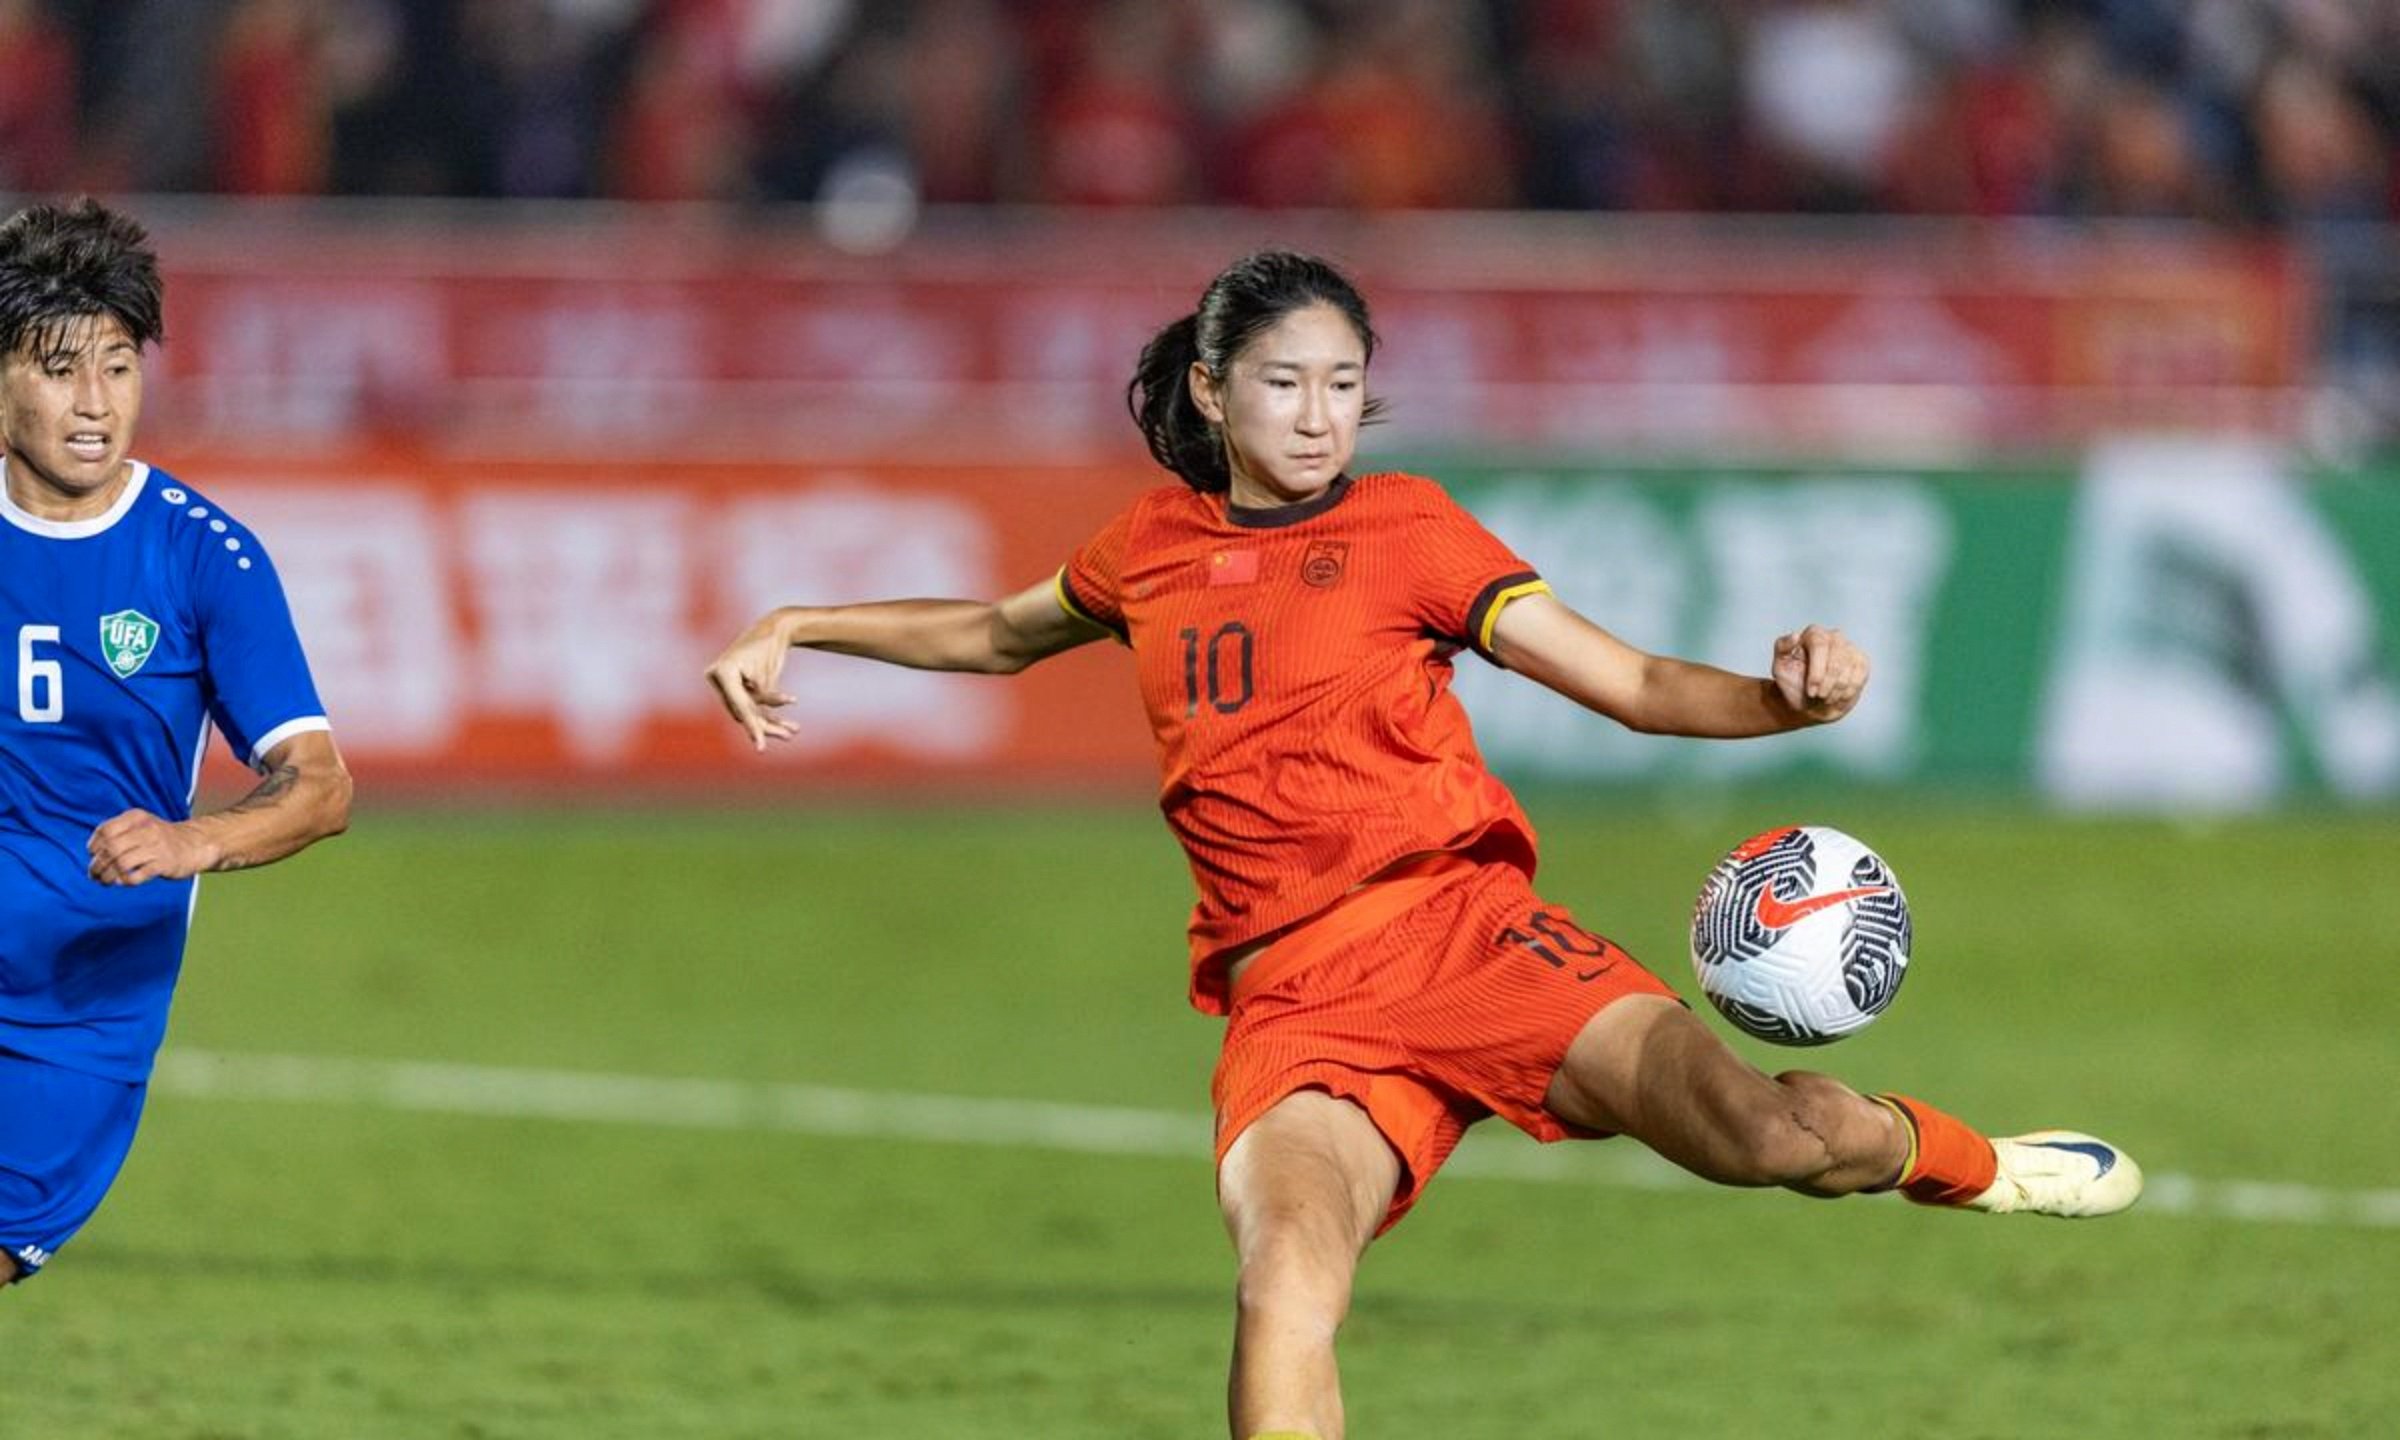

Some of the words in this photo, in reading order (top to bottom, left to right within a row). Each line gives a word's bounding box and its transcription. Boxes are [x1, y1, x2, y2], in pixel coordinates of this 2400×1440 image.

[110, 619, 148, 649] UFA
[1179, 621, 1254, 717] 10
[19, 624, 63, 723] 6
[1495, 911, 1606, 968] 10
